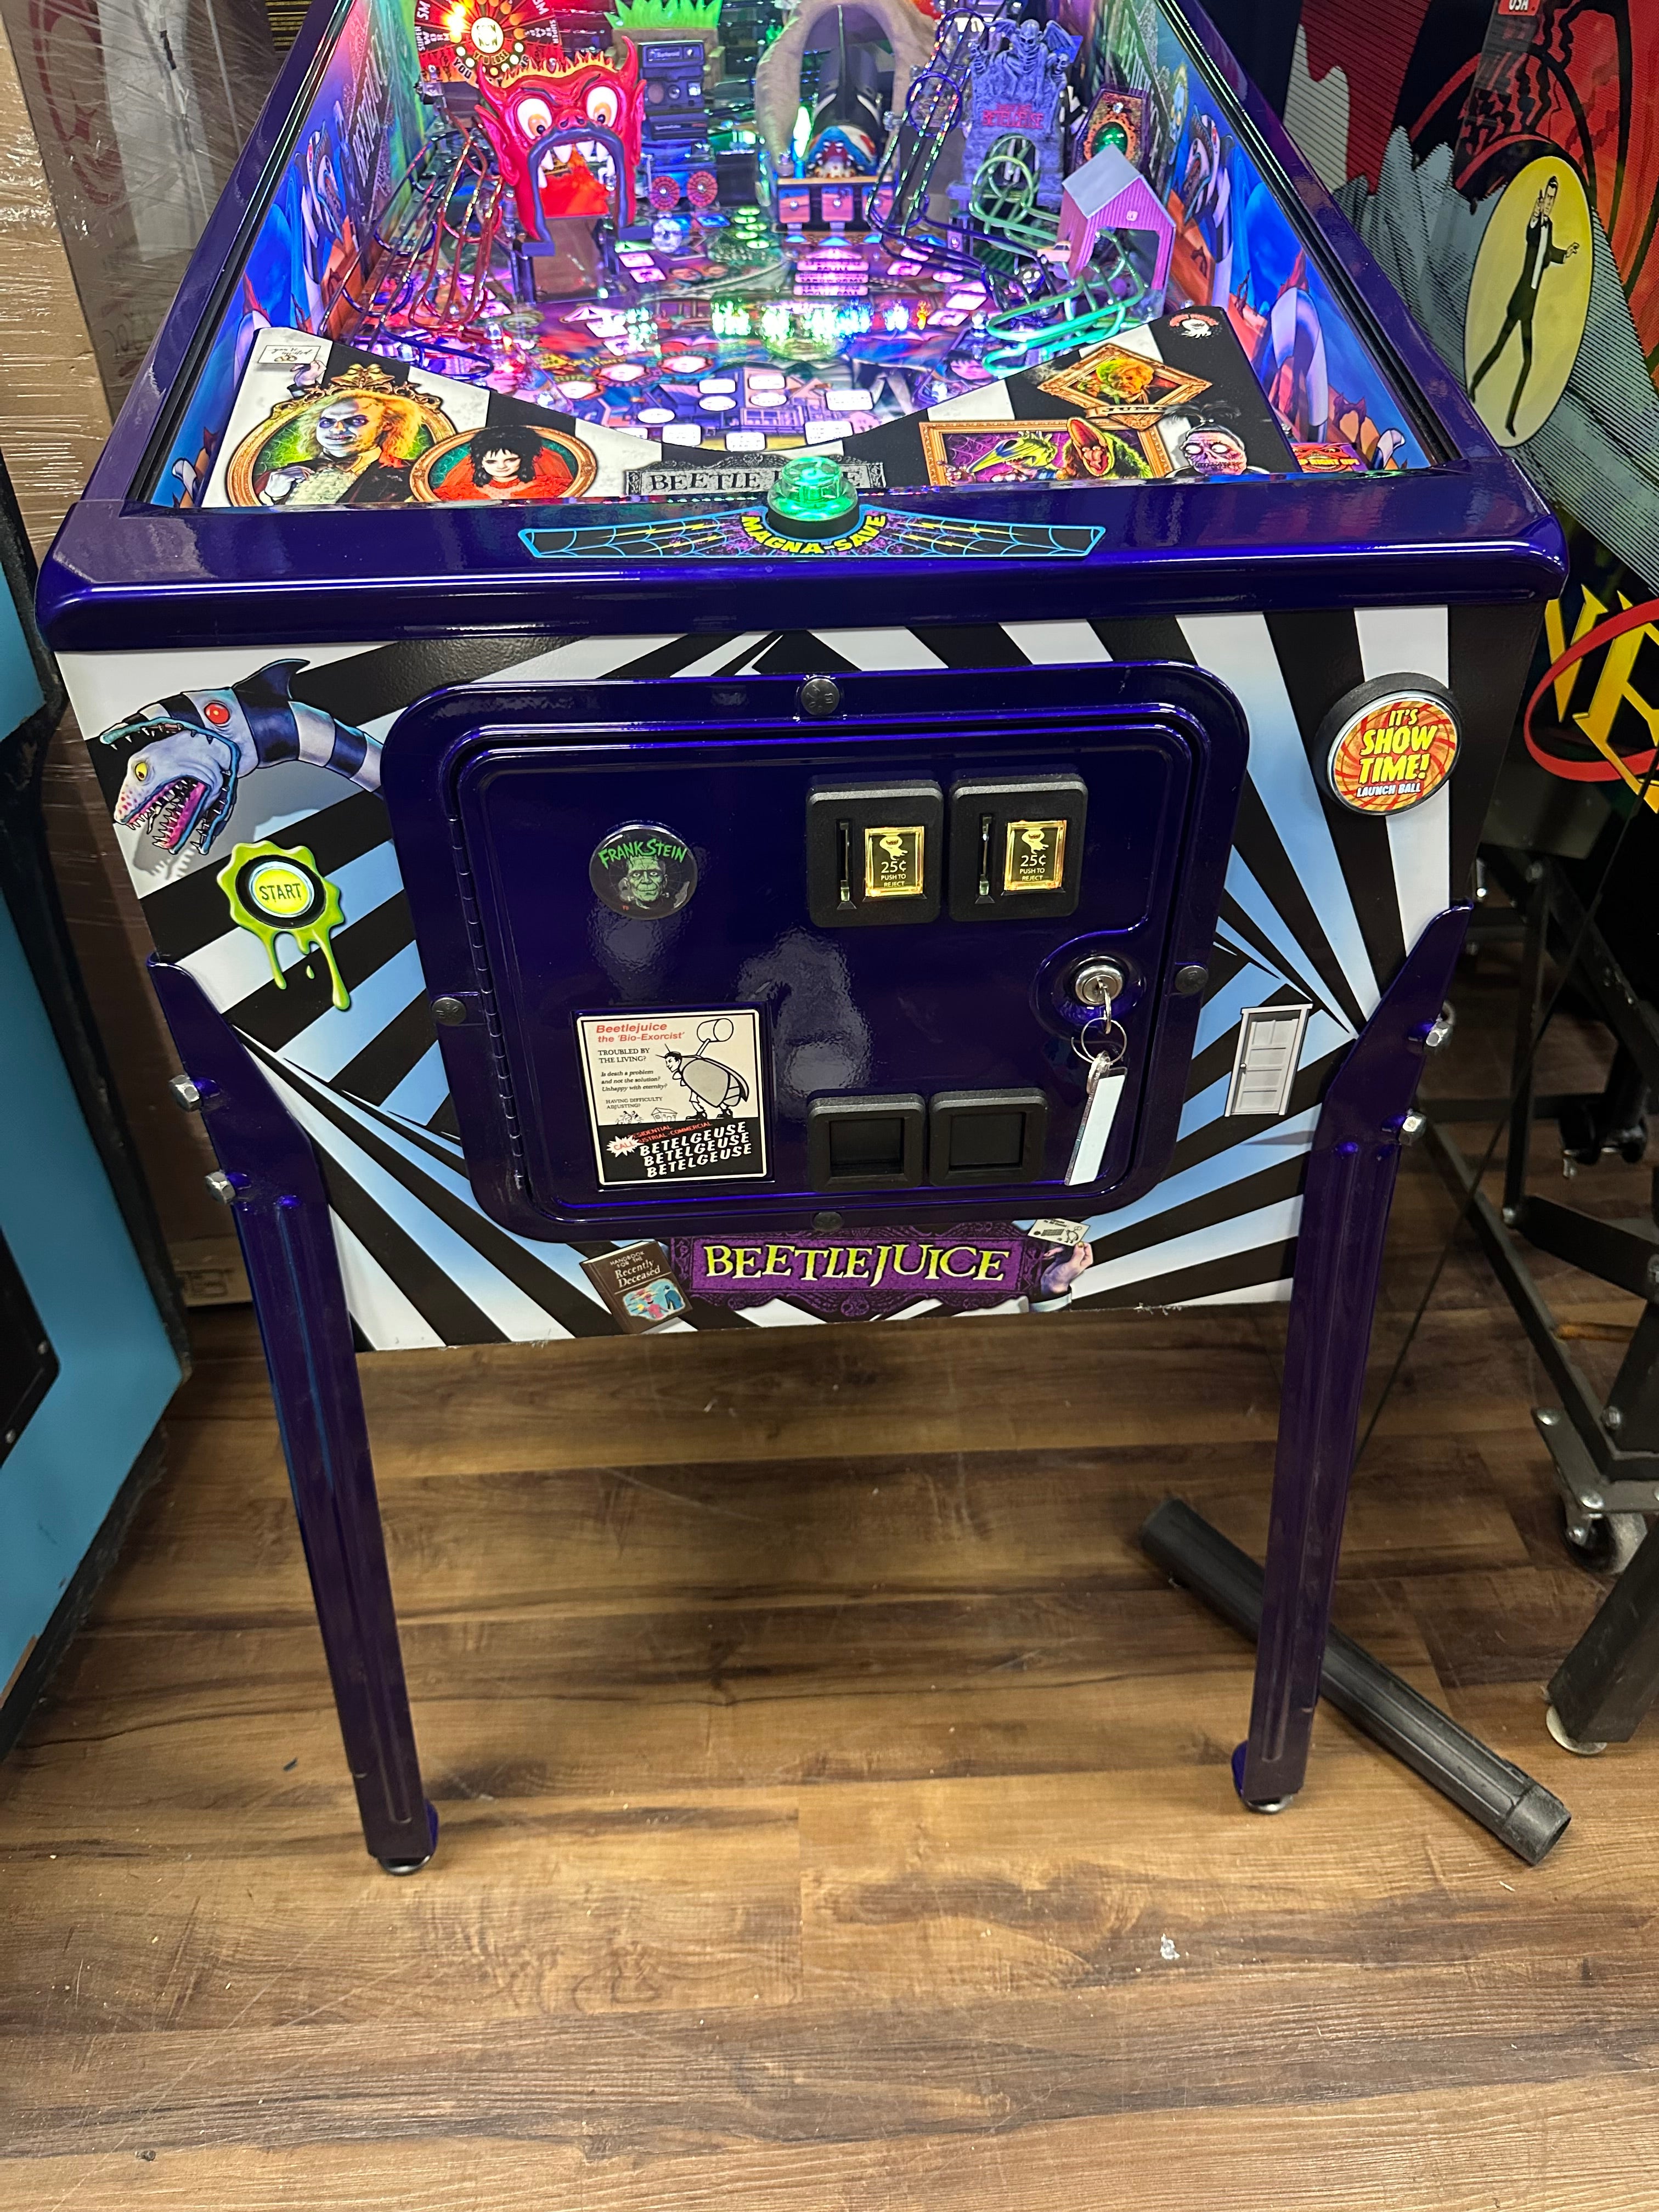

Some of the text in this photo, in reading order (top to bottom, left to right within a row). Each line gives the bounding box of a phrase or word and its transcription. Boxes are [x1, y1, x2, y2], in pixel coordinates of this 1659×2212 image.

[453, 58, 472, 80] YOU
[741, 515, 886, 554] MAGNA-SAVE
[1388, 708, 1419, 727] IT'S
[1359, 725, 1438, 755] SHOW
[1358, 753, 1430, 785] TIME!
[1356, 782, 1421, 798] LAUNCH BALL
[881, 860, 906, 873] 25¢
[1020, 854, 1046, 867] 25¢
[258, 883, 302, 902] START
[596, 1022, 668, 1034] Beetlejuice
[618, 1031, 685, 1042] 'Bio-Exorcist'
[629, 1125, 673, 1139] ESIDENTIAL
[639, 1121, 746, 1157] BETELGEUSE
[613, 1141, 636, 1152] CALL
[643, 1131, 750, 1167] BETELGEUSE
[646, 1143, 753, 1178] BETELGEUSE
[610, 1250, 645, 1266] HANDBOOK
[703, 1243, 1009, 1287] BEETLEJUICE
[614, 1260, 654, 1279] Recently
[618, 1265, 661, 1288] Deceased
